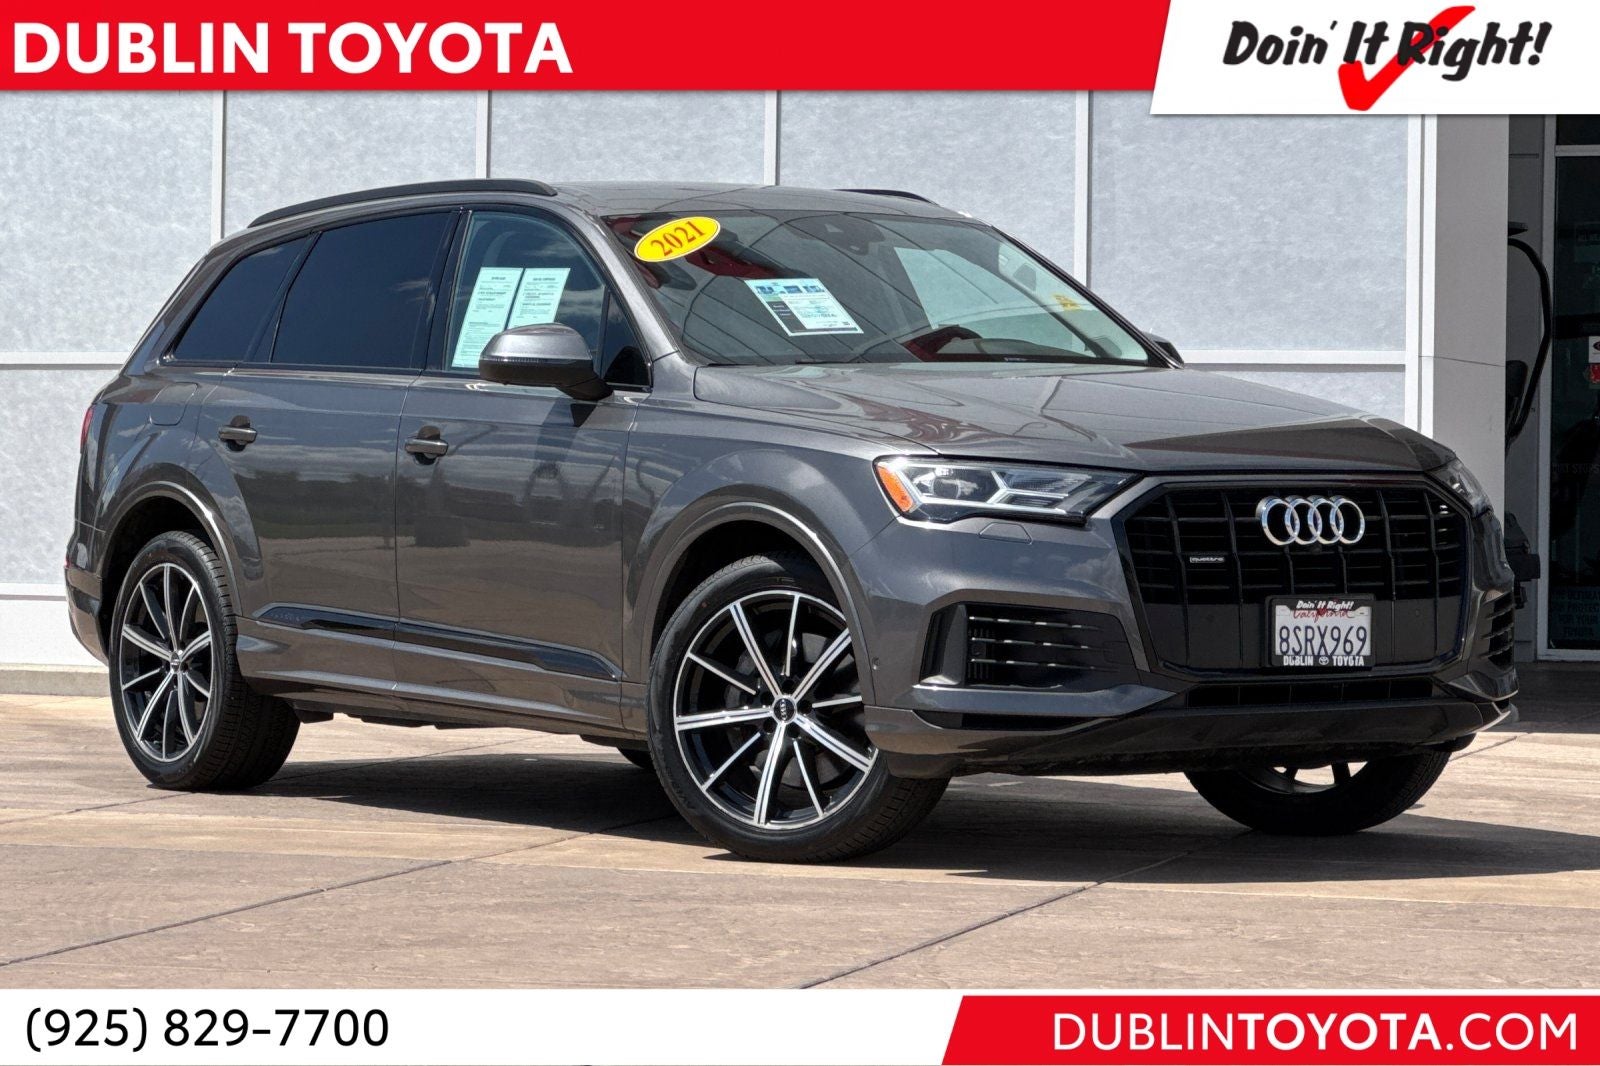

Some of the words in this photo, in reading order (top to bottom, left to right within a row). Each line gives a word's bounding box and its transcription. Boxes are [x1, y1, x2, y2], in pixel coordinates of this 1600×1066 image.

[650, 221, 704, 256] 2021
[1296, 600, 1317, 609] Doin'
[1327, 600, 1355, 611] Right!
[1279, 625, 1368, 656] 8SRX969
[1283, 655, 1314, 666] DUBLIN
[1332, 655, 1365, 667] TOYOTA
